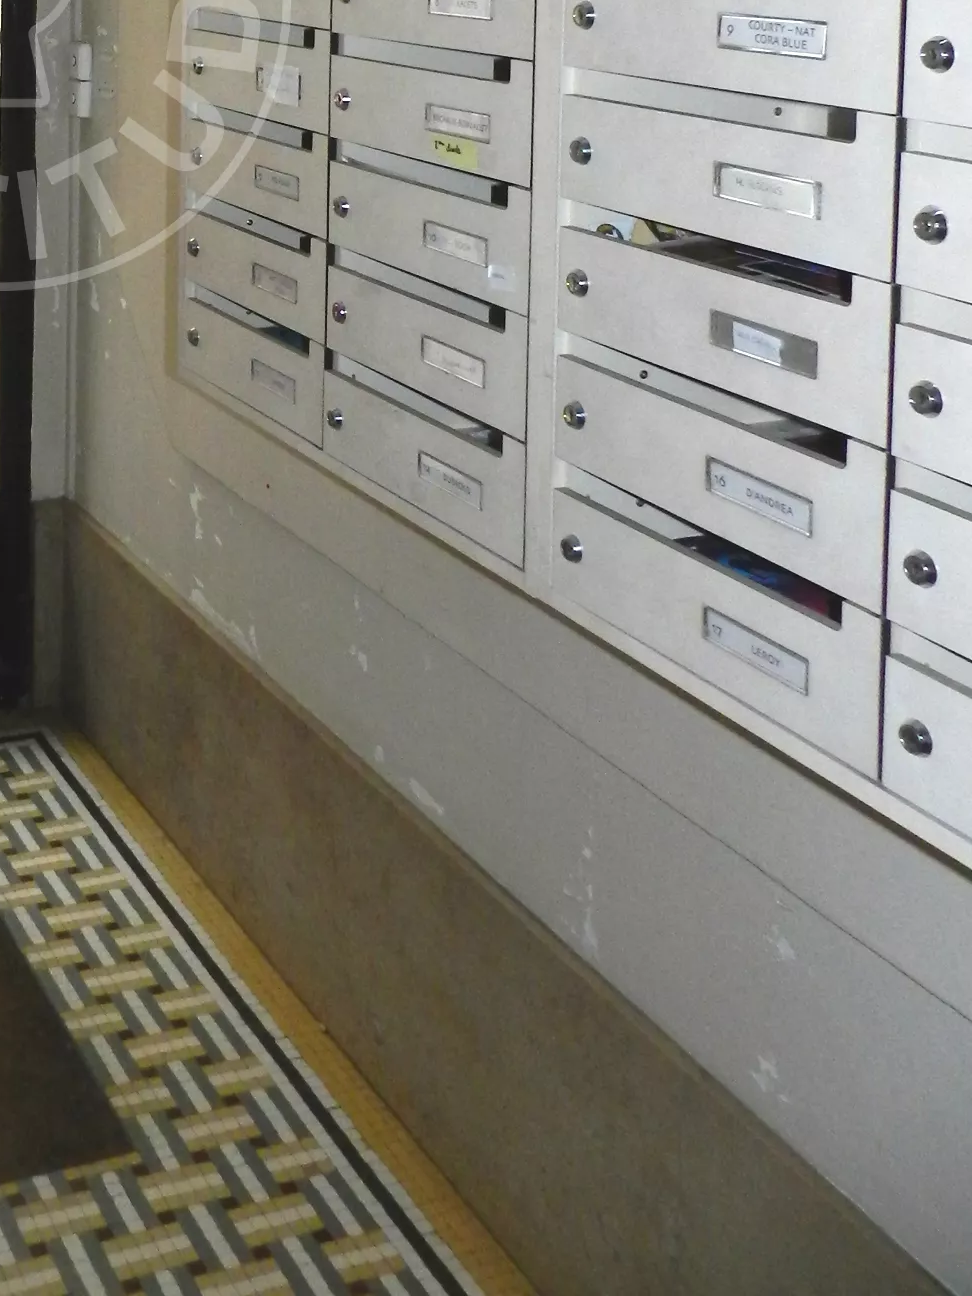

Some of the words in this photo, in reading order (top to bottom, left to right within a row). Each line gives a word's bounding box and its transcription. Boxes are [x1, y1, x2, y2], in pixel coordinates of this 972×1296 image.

[726, 24, 734, 36] 9
[748, 20, 785, 33] COURTY
[795, 26, 816, 37] NAT
[754, 33, 779, 46] CORA
[782, 37, 807, 50] BLUE
[714, 474, 726, 487] 16
